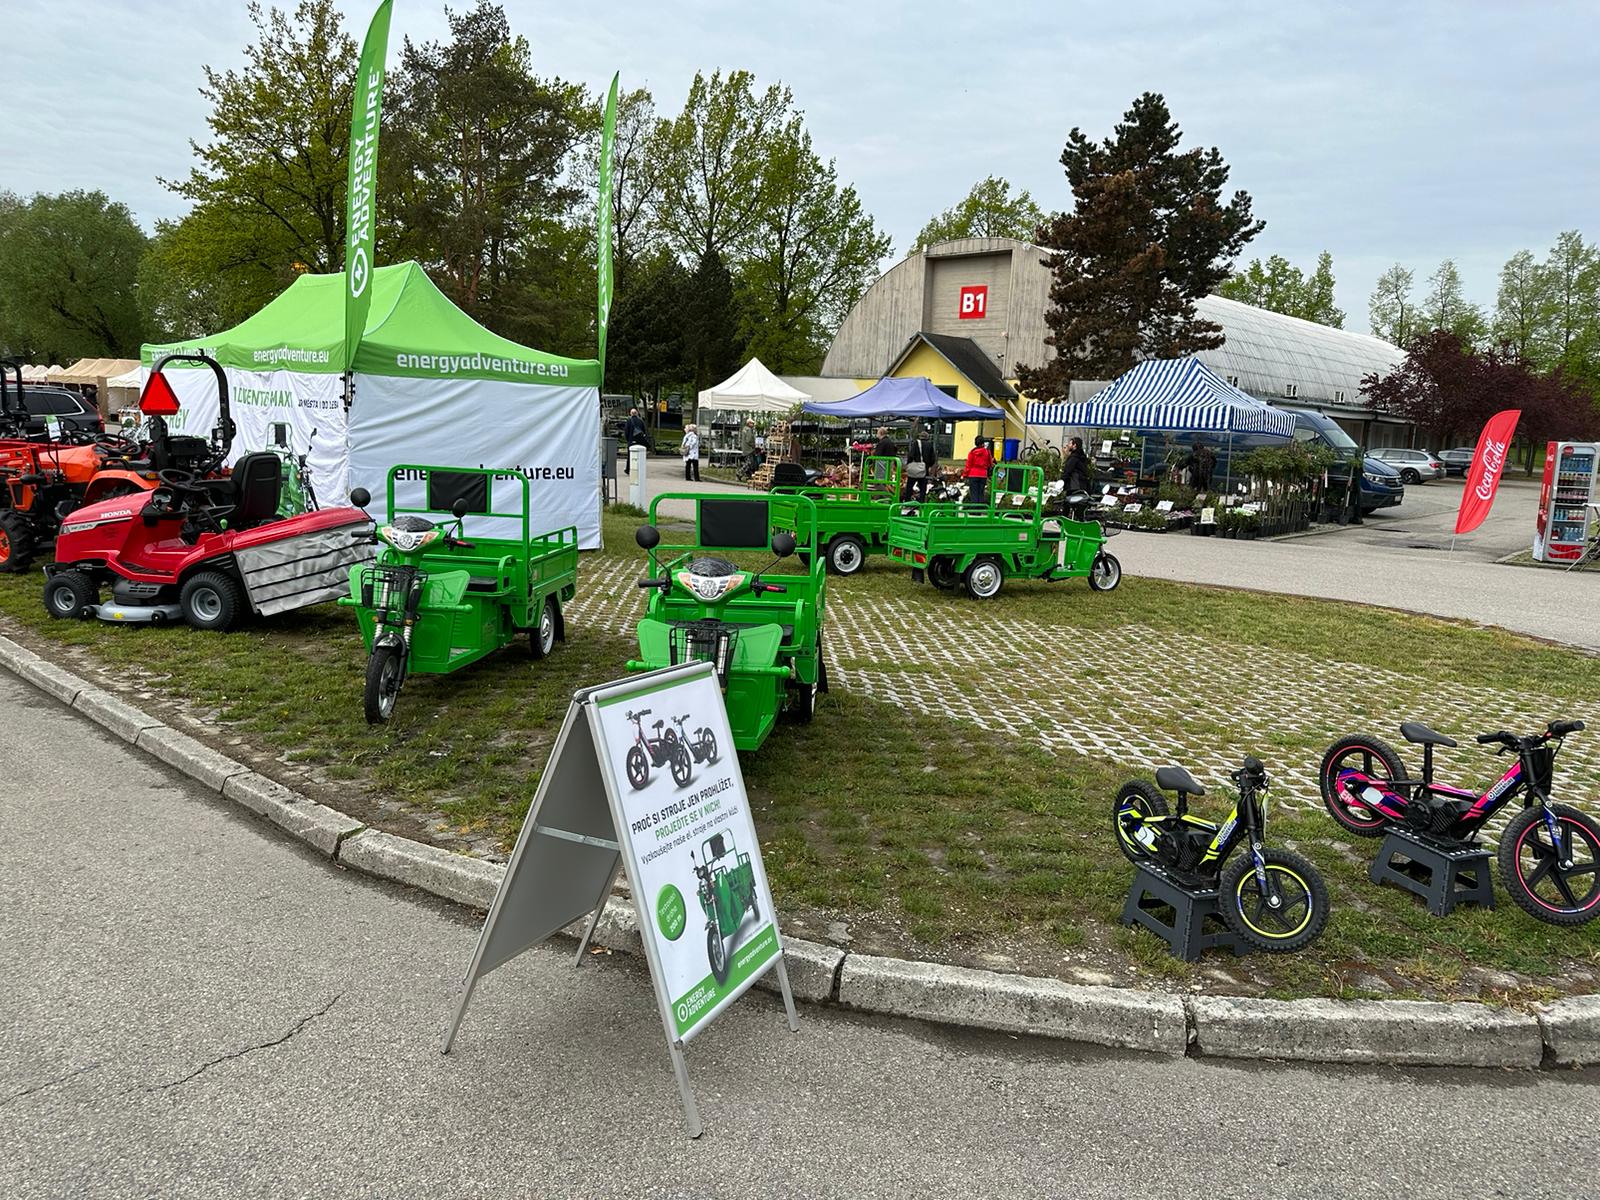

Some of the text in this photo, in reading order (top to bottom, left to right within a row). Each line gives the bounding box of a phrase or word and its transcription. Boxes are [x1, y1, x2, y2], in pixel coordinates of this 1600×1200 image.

[360, 70, 380, 241] ADVENTURE
[352, 138, 365, 248] ENERGY
[962, 293, 985, 313] B1
[253, 346, 329, 363] energyadventure.eu
[396, 353, 569, 378] energyadventure.eu
[1475, 437, 1505, 500] Coca-Cola
[100, 510, 132, 519] HONDA
[631, 813, 653, 835] PROČ
[652, 811, 661, 825] SI
[661, 799, 687, 821] STROJE
[687, 792, 701, 808] JEN
[654, 816, 690, 841] PROJEĎTE
[689, 811, 699, 824] SE
[698, 808, 704, 819] V
[640, 841, 673, 865] Vyzkoušejte
[673, 835, 687, 848] naše
[692, 823, 707, 837] stroje
[706, 818, 714, 828] na
[737, 936, 773, 969] energyadventure.eu
[686, 986, 705, 1008] ENERGY
[688, 987, 716, 1017] ADVENTURE
